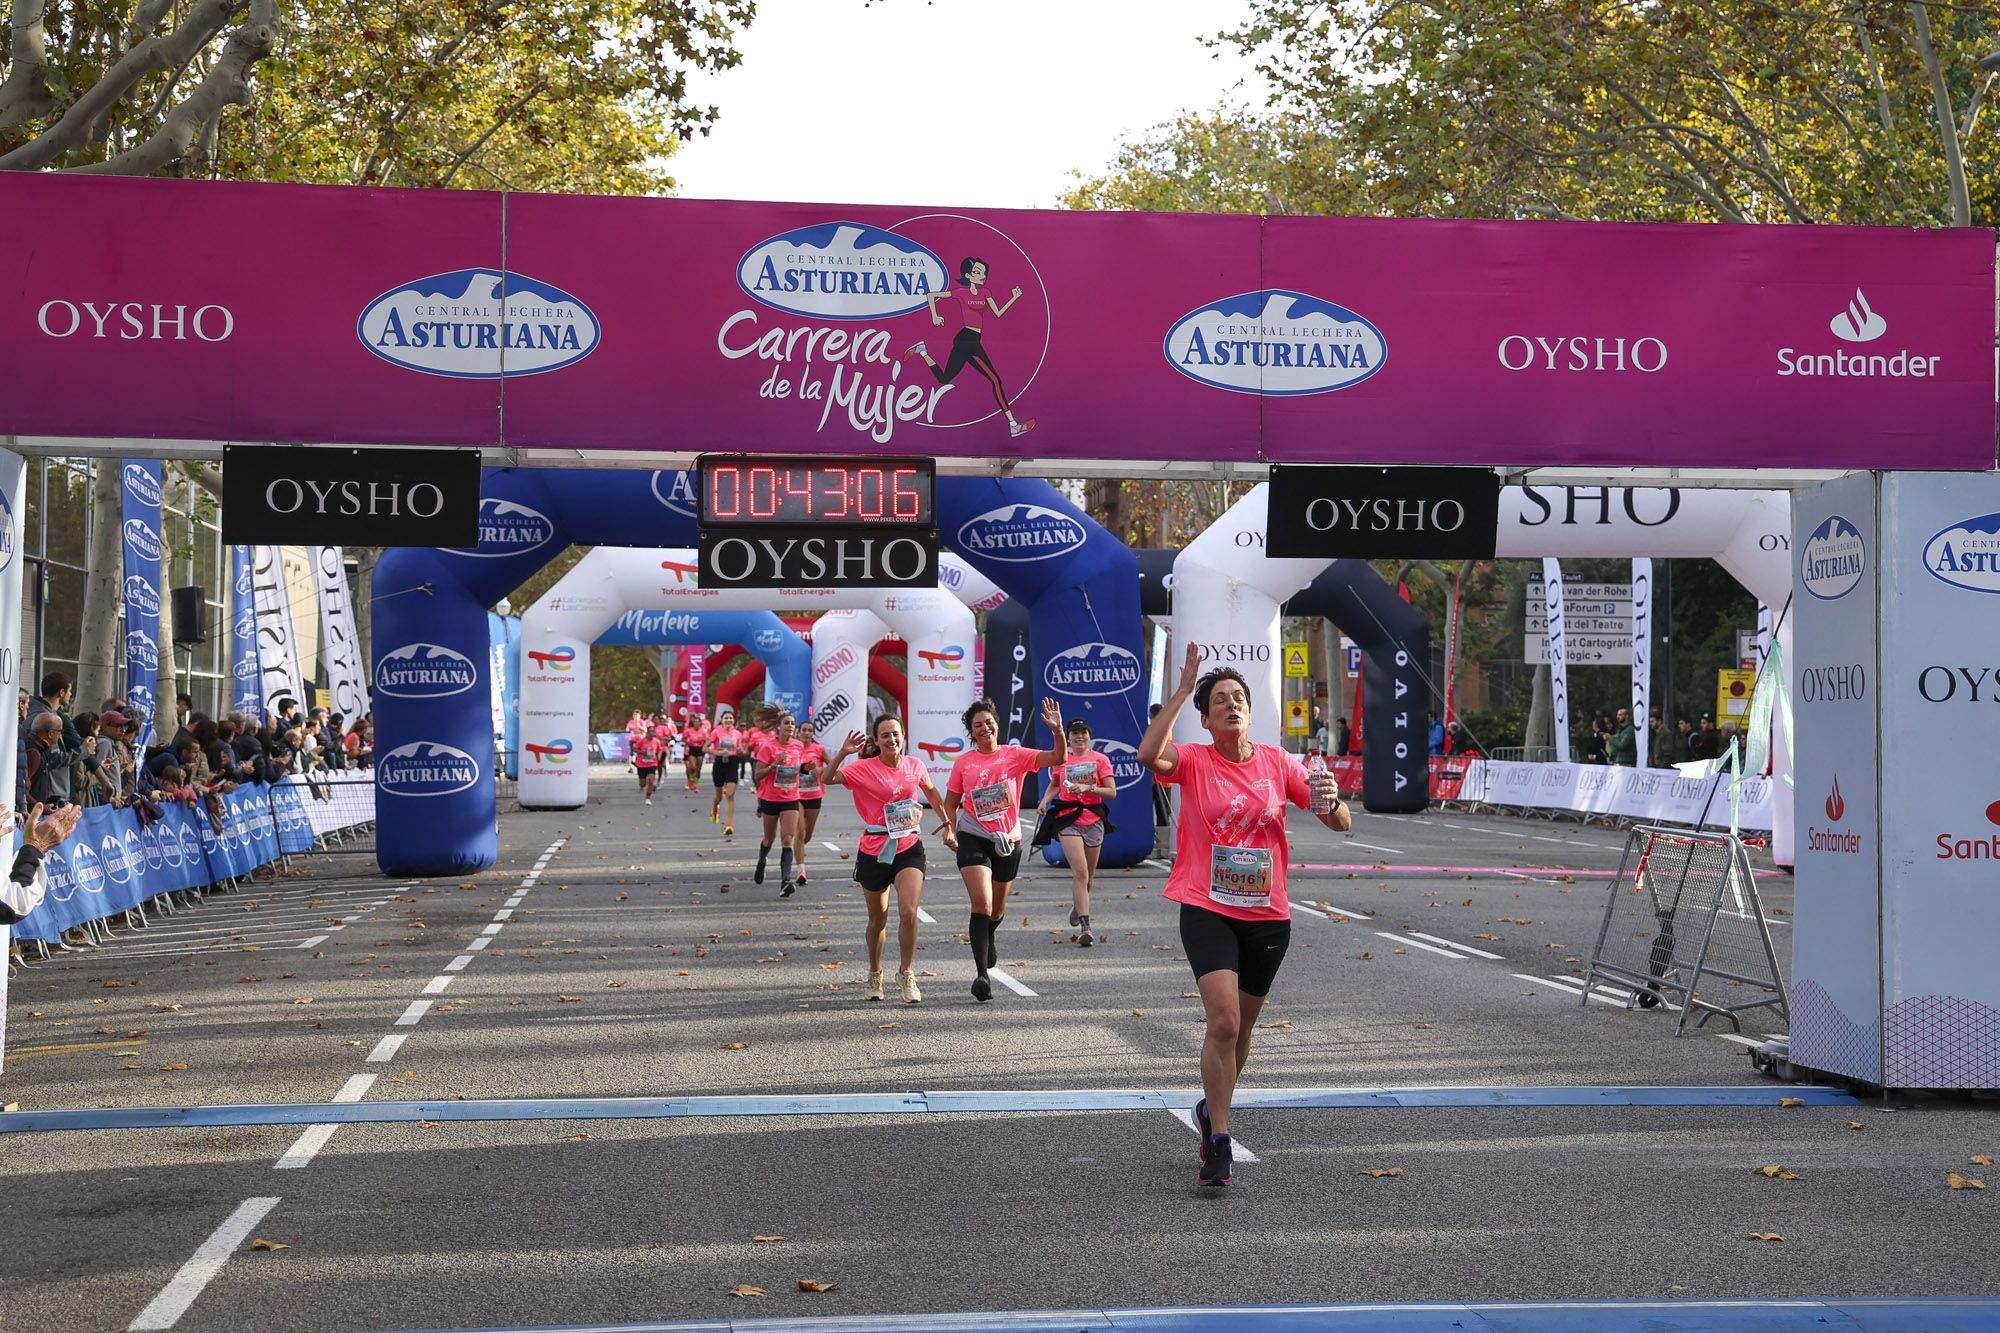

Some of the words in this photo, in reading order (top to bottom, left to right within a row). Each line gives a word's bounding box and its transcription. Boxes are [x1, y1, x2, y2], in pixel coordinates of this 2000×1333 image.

[753, 254, 931, 295] ASTURIANA
[786, 254, 853, 266] CENTRAL
[859, 256, 926, 268] LECHERA
[37, 299, 235, 343] OYSHO
[414, 305, 490, 317] CENTRAL
[498, 306, 575, 319] LECHERA
[376, 306, 582, 350] ASTURIANA
[717, 309, 892, 364] Carrera
[1216, 324, 1285, 336] CENTRAL
[1292, 327, 1363, 338] LECHERA
[1181, 326, 1370, 369] ASTURIANA
[1497, 334, 1668, 373] OYSHO
[1777, 347, 1940, 378] Santander
[759, 364, 792, 398] de
[799, 364, 822, 399] la
[816, 360, 956, 443] Mujer
[265, 477, 445, 518] OYSHO
[713, 467, 919, 517] 00:43:06
[1519, 485, 1681, 527] SHO
[984, 522, 1028, 533] CENTRAL
[1030, 520, 1072, 530] LECHERA
[1304, 497, 1465, 534] OYSHO
[479, 526, 543, 542] RIANA
[968, 528, 1079, 551] ASTURIANA
[709, 538, 928, 581] OYSHO
[1805, 551, 1861, 582] ASTURIANA
[661, 587, 719, 597] TotalEnergies
[779, 587, 836, 597] TotalEnergies
[1568, 588, 1583, 596] van
[1586, 586, 1601, 596] der
[1603, 586, 1628, 596] Rohe
[617, 609, 700, 638] Marlene
[1574, 619, 1589, 629] del
[1593, 619, 1624, 629] Teatre
[380, 666, 470, 687] ASTURIANA
[527, 675, 575, 684] TotalEnergies
[815, 647, 854, 684] COSMO
[917, 674, 965, 682] TotalEnergies
[1050, 664, 1137, 685] ASTURIANA
[1802, 663, 1866, 703] OYSHO
[814, 693, 850, 733] COSMO
[1395, 650, 1408, 792] VOLVO
[381, 764, 472, 784] ASTURIANA
[525, 768, 572, 777] TotalEnergies
[1808, 827, 1861, 854] Santander
